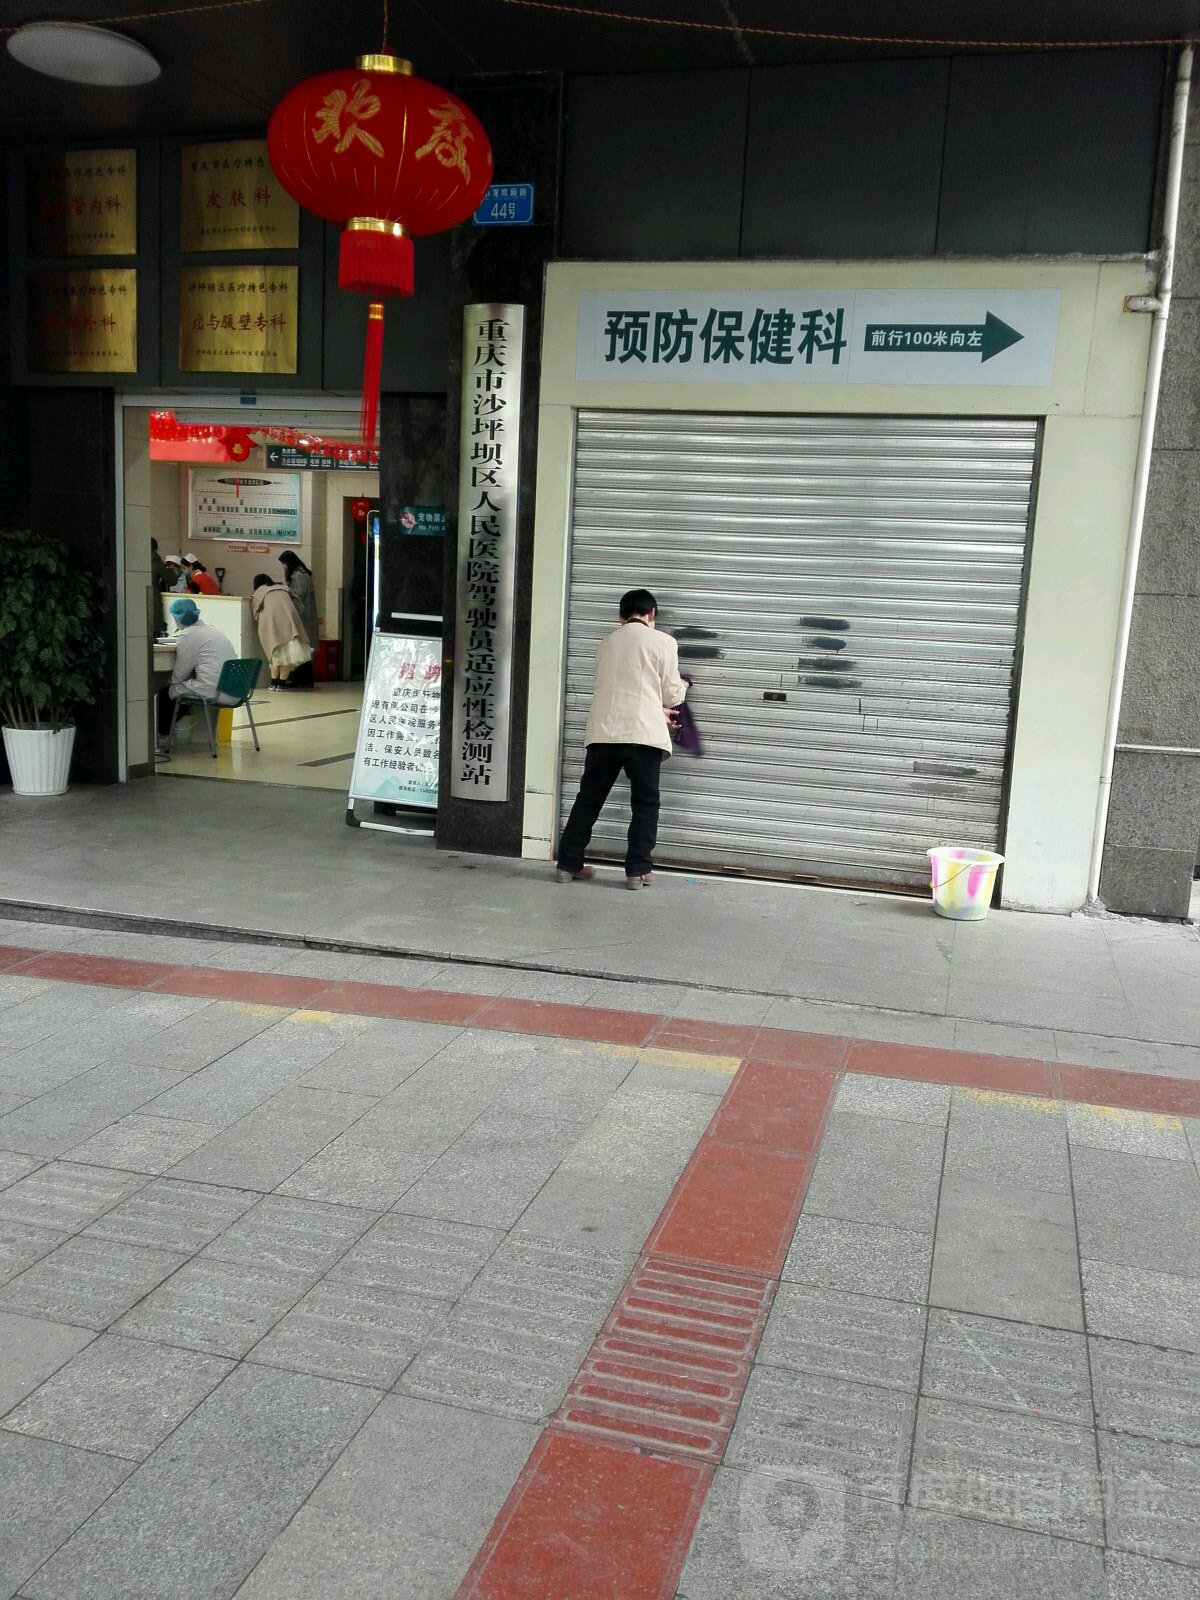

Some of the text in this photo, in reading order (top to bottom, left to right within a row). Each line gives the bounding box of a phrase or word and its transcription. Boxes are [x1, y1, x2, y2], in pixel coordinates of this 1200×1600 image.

[490, 202, 516, 219] 44号
[604, 307, 847, 365] 预防保健科
[871, 329, 984, 348] 前行100米向左
[461, 318, 510, 786] 重庆市沙坪坝区人民医院驾驶员适应性检测站
